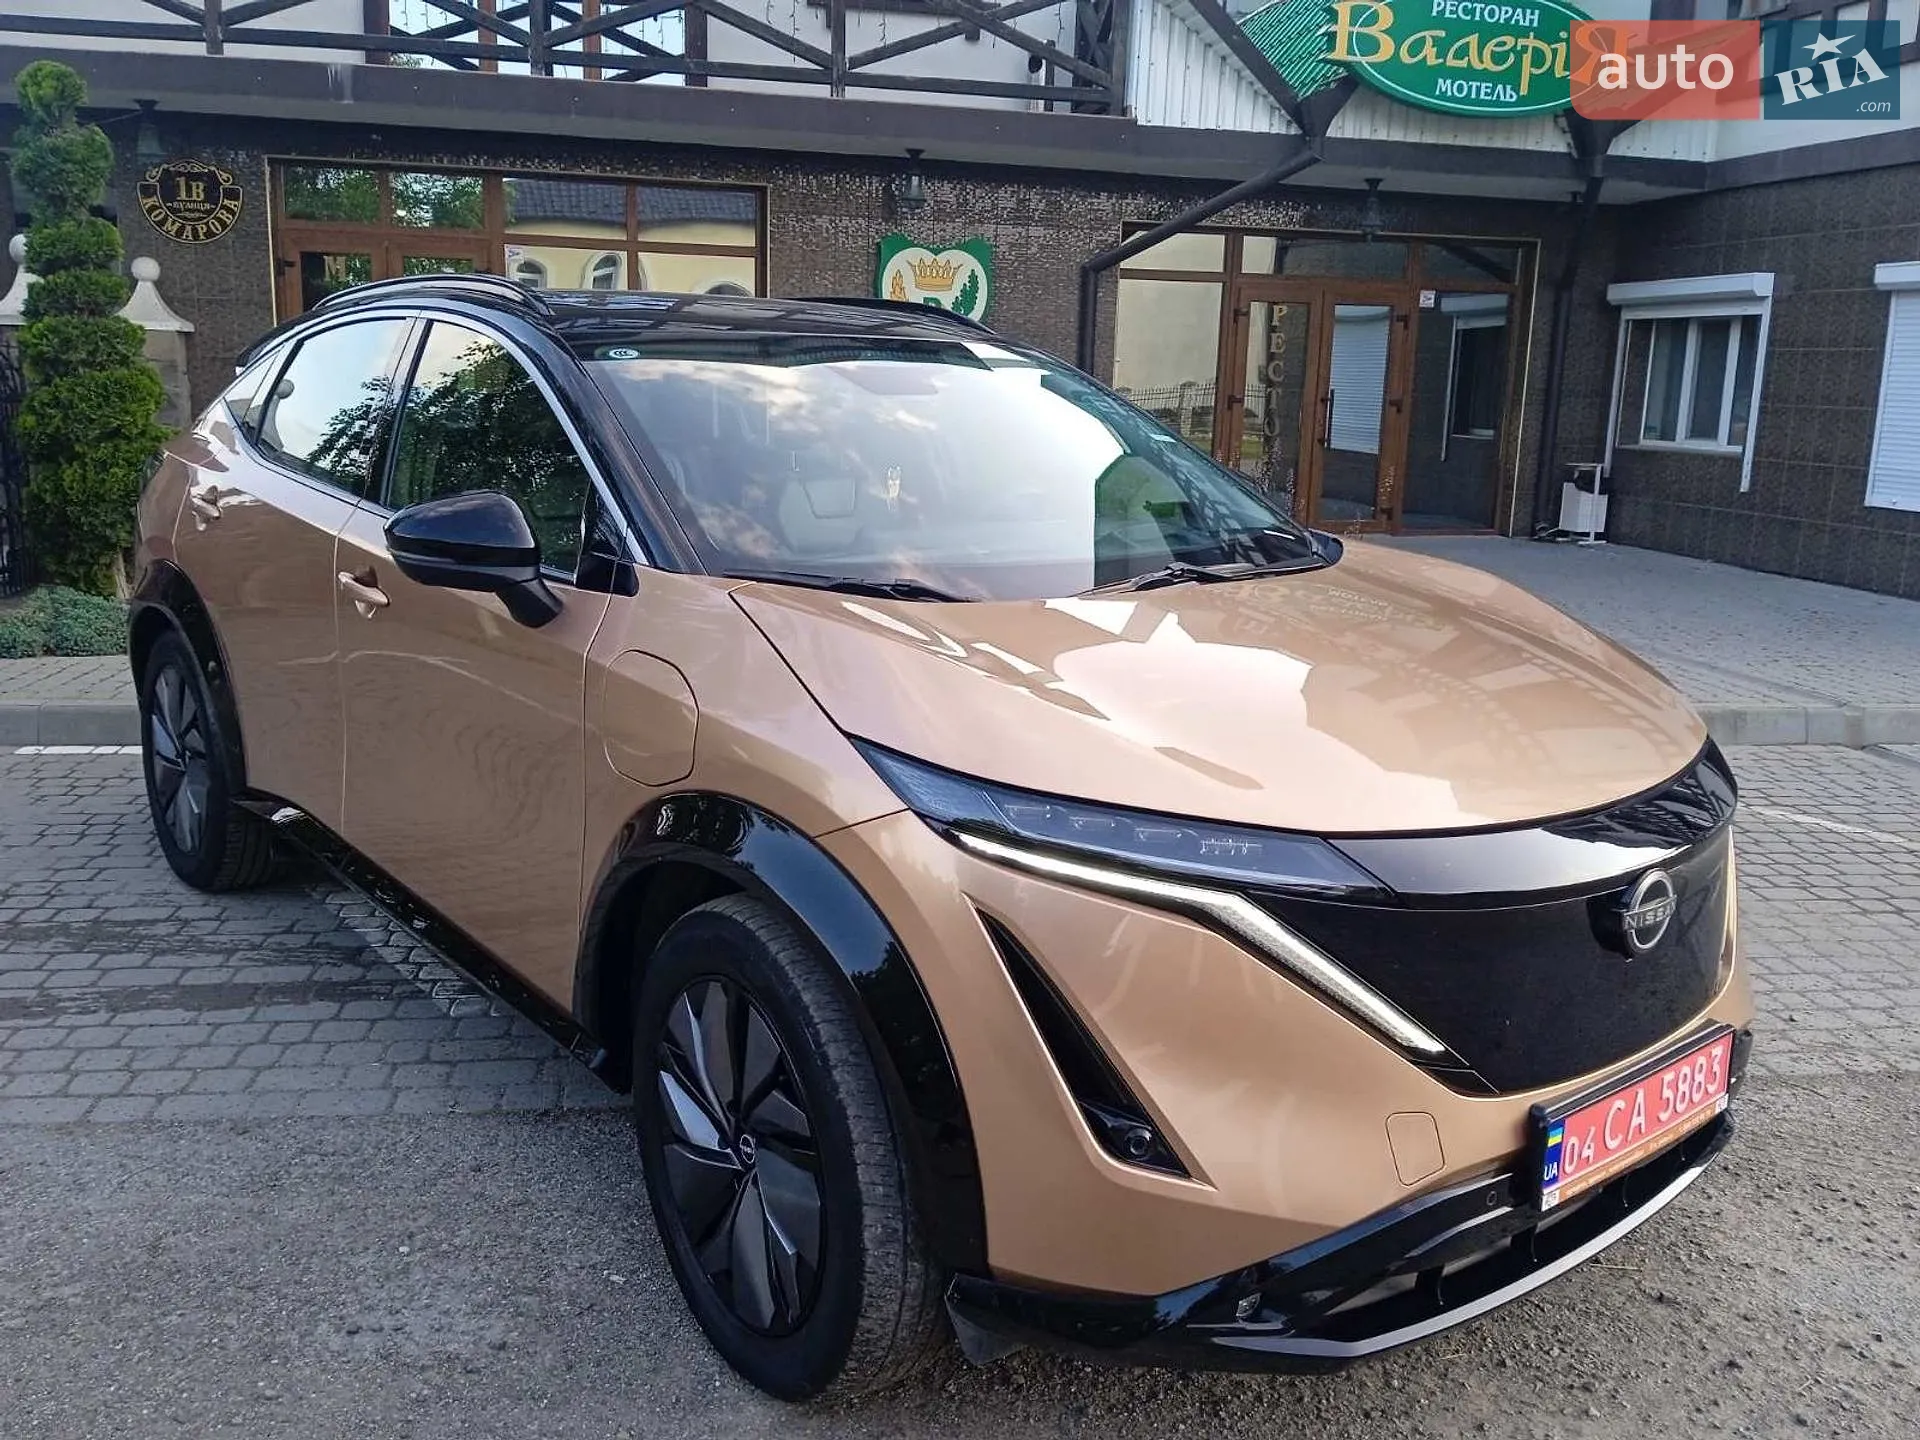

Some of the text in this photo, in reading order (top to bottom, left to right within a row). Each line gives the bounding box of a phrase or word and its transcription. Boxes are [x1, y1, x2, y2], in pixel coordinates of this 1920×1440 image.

[1431, 0, 1539, 27] РЕСТОРАН
[1435, 78, 1518, 102] МОТЕЛЬ
[142, 195, 239, 240] КОМАРОВА
[1564, 1126, 1596, 1174] 04
[1657, 1046, 1723, 1122] 5883
[1544, 1162, 1558, 1180] UA
